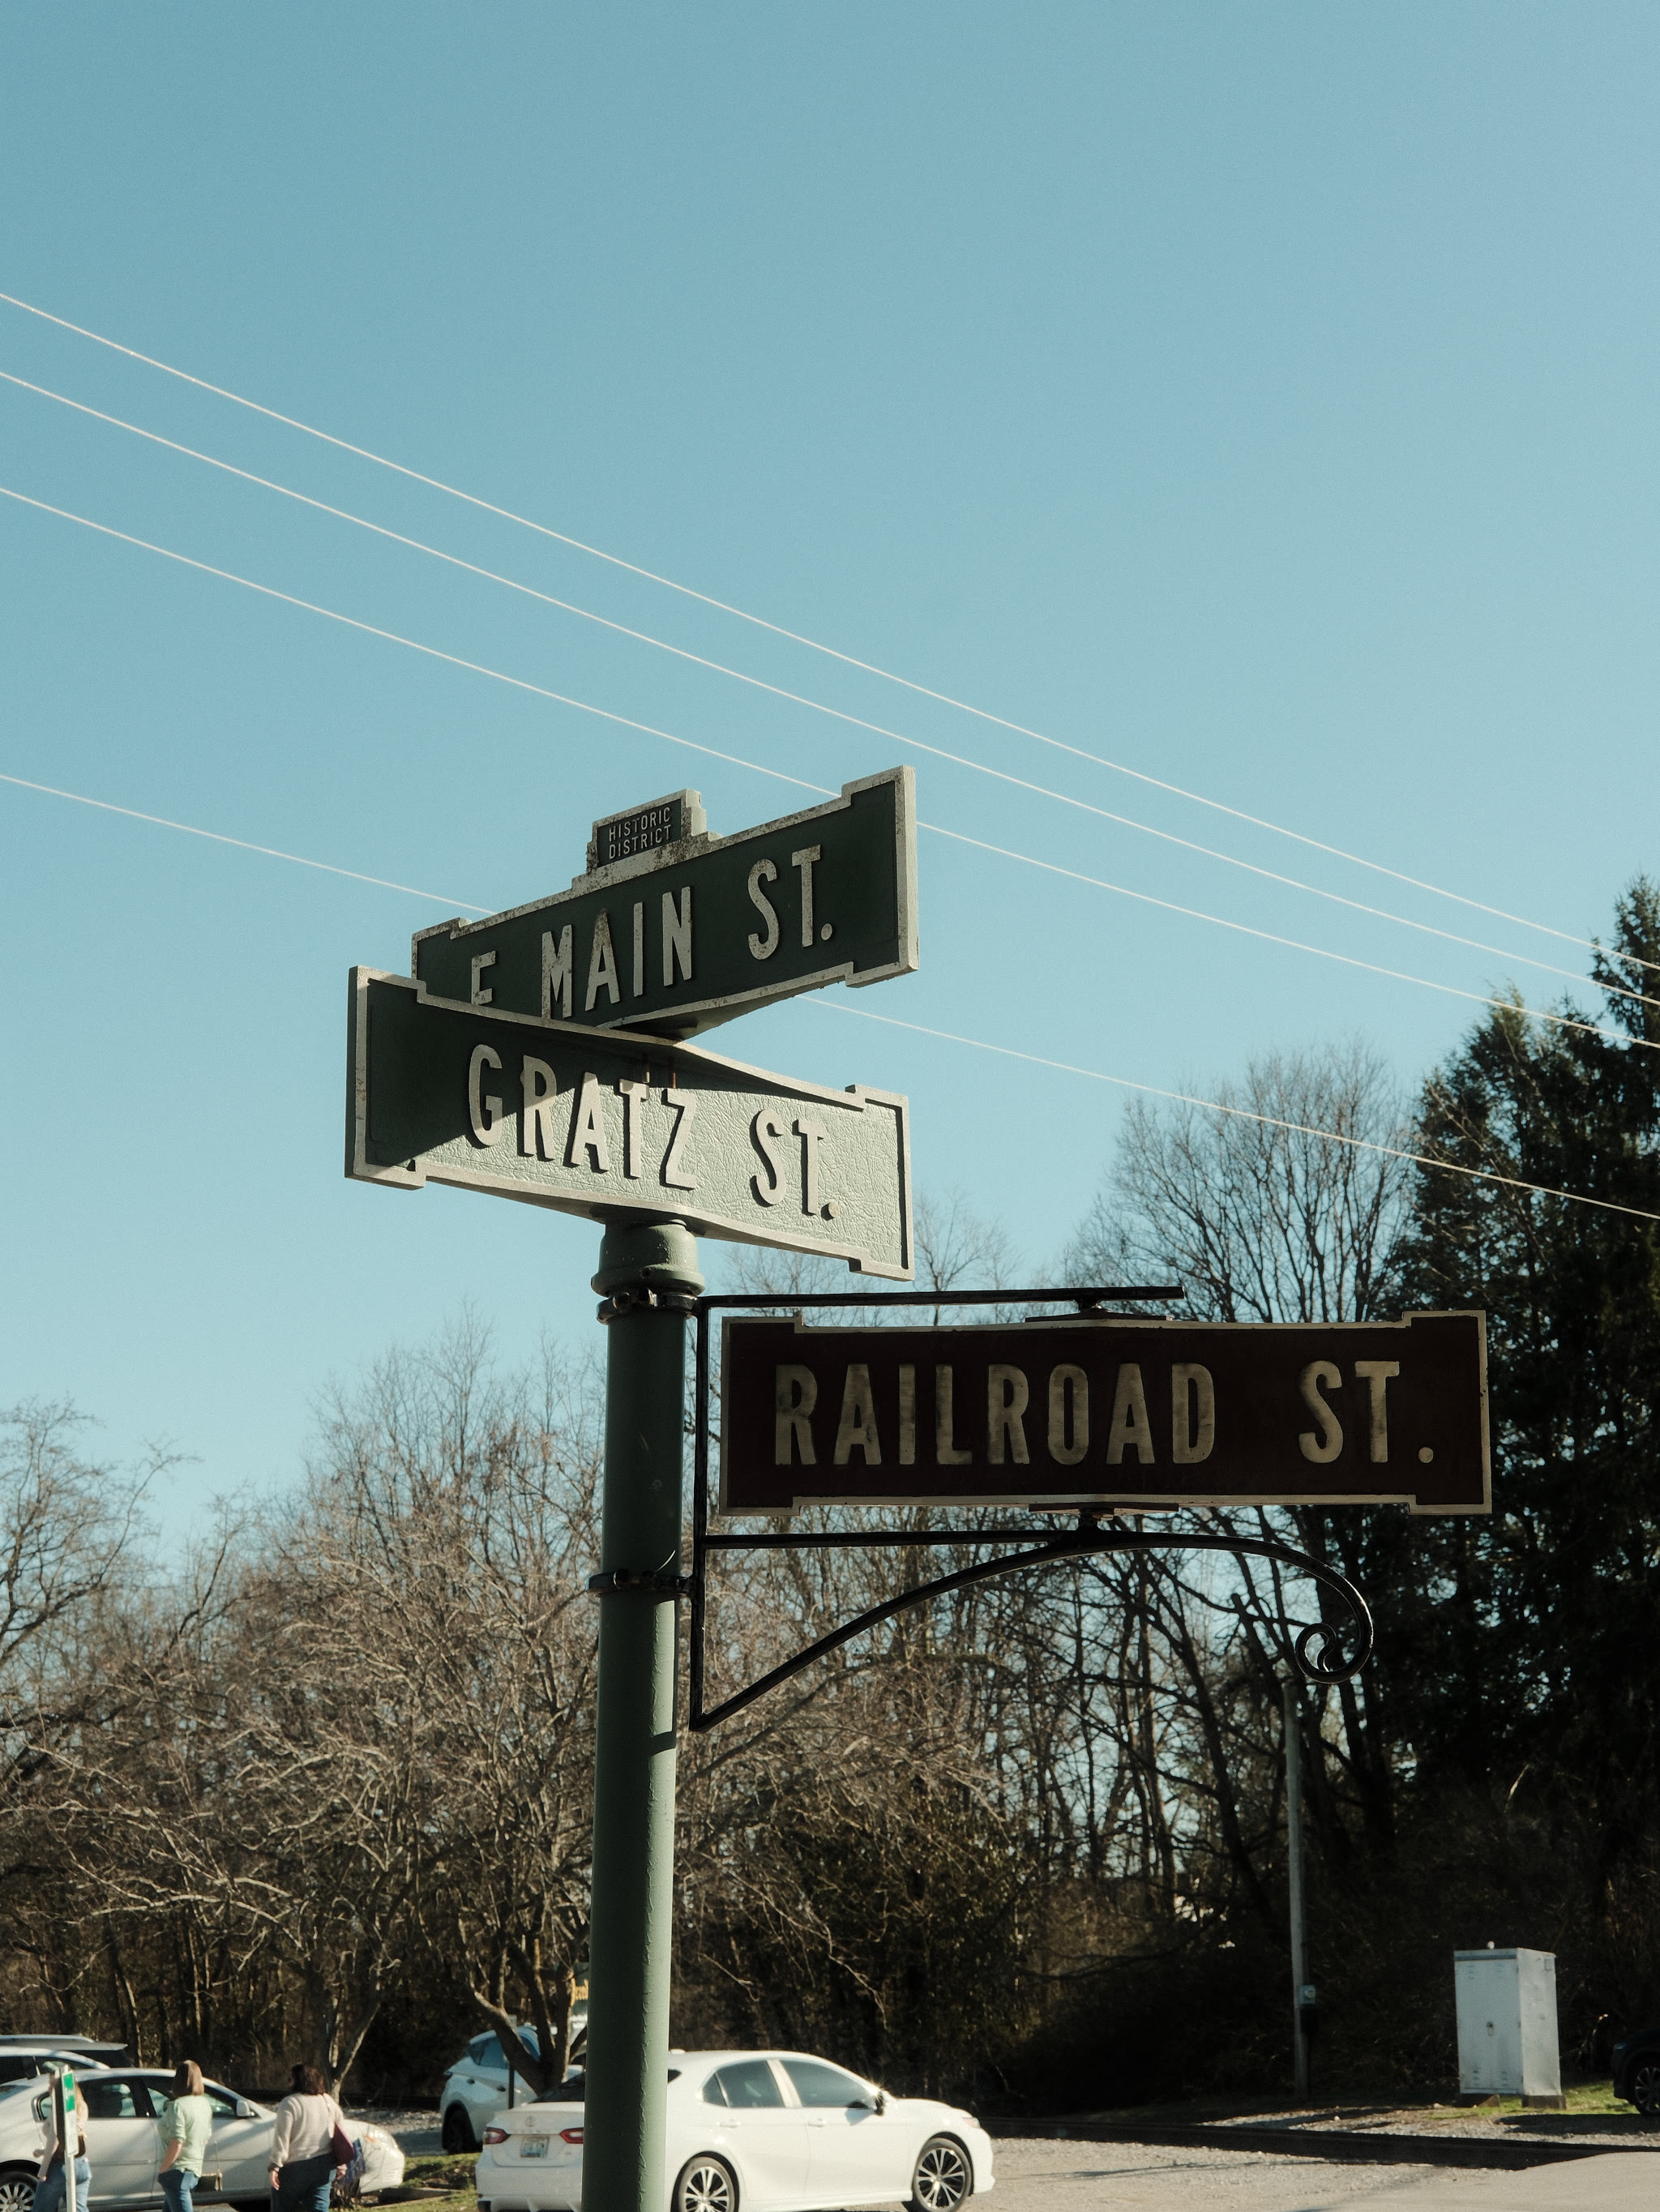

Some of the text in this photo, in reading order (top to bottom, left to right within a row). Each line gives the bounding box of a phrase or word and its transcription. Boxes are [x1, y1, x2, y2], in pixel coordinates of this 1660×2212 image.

[609, 807, 670, 842] HISTORIC
[609, 824, 671, 859] DISTRICT
[541, 887, 692, 1020] MAIN
[747, 845, 833, 960] ST.
[468, 1045, 840, 1220] GRATZ ST.
[775, 1360, 1435, 1465] RAILROAD ST.
